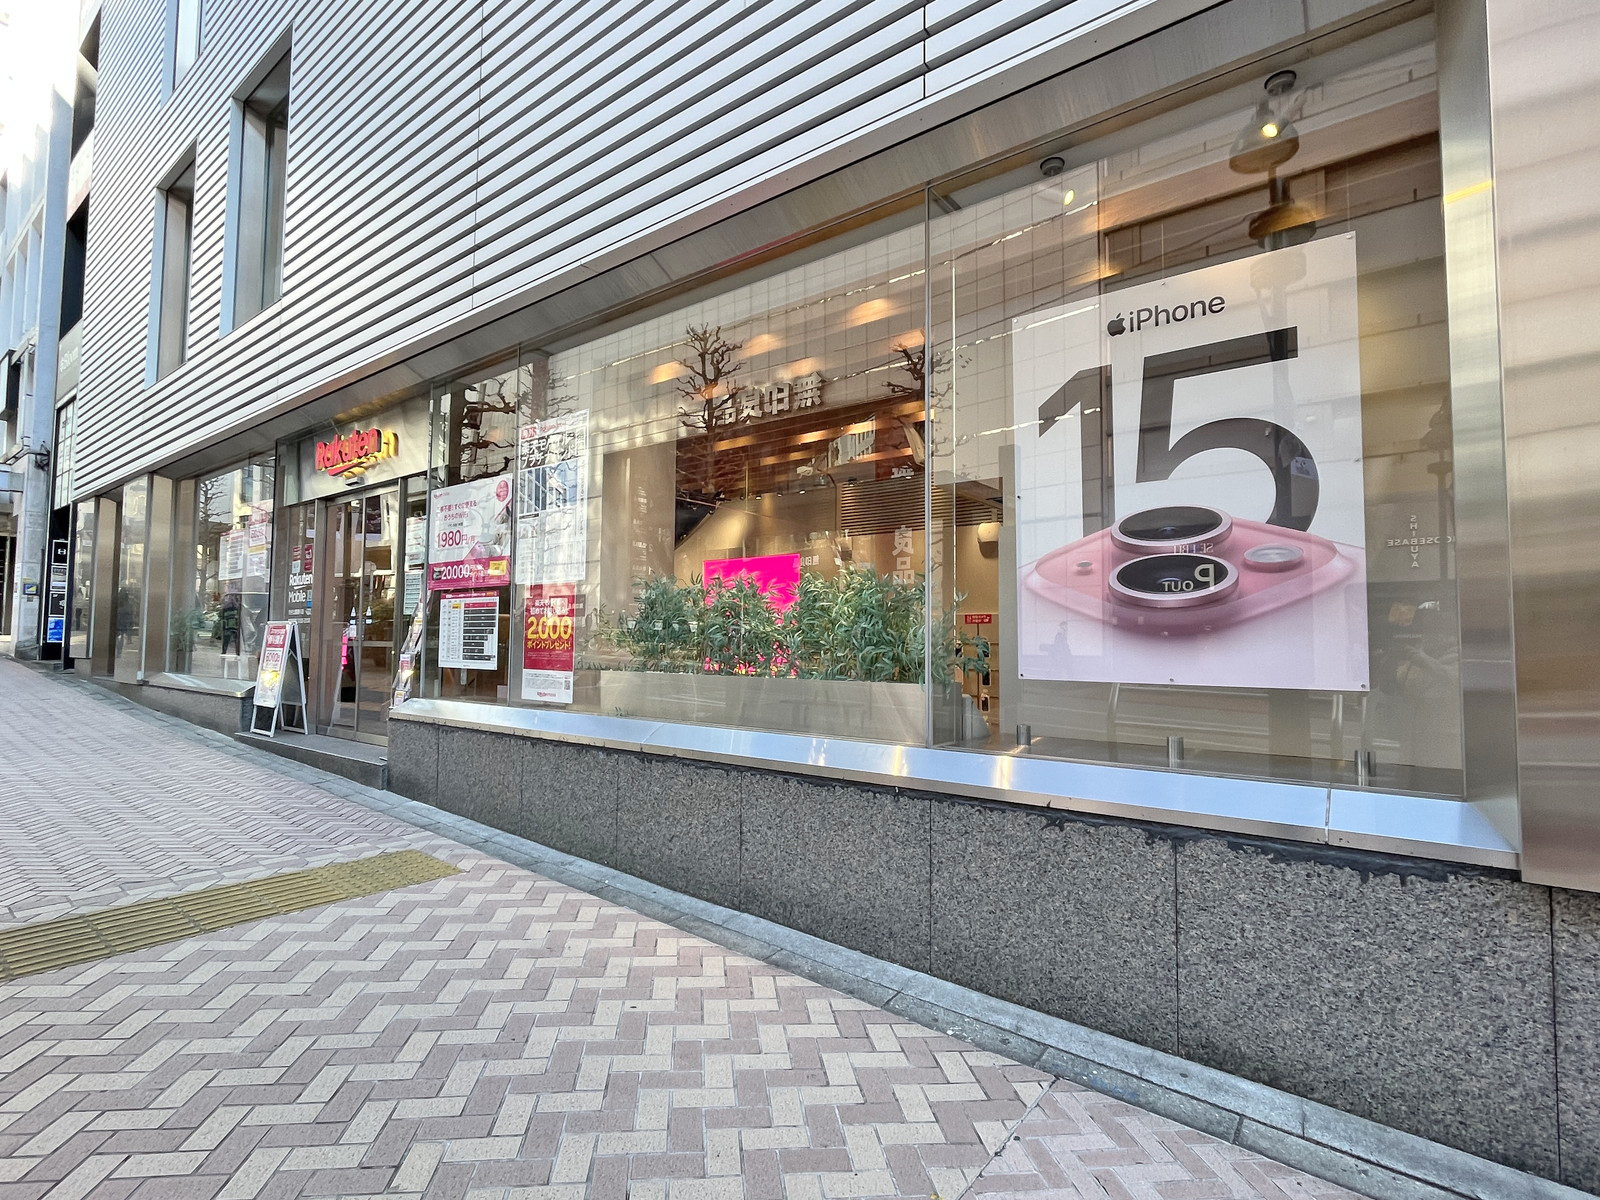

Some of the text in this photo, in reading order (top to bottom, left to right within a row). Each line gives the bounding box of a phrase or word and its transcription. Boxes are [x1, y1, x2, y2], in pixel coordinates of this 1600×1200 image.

[1129, 295, 1226, 333] iPhone
[315, 427, 382, 471] Rakuten
[1038, 325, 1320, 538] 15
[288, 589, 306, 603] Mobile
[289, 572, 314, 587] Rakuten
